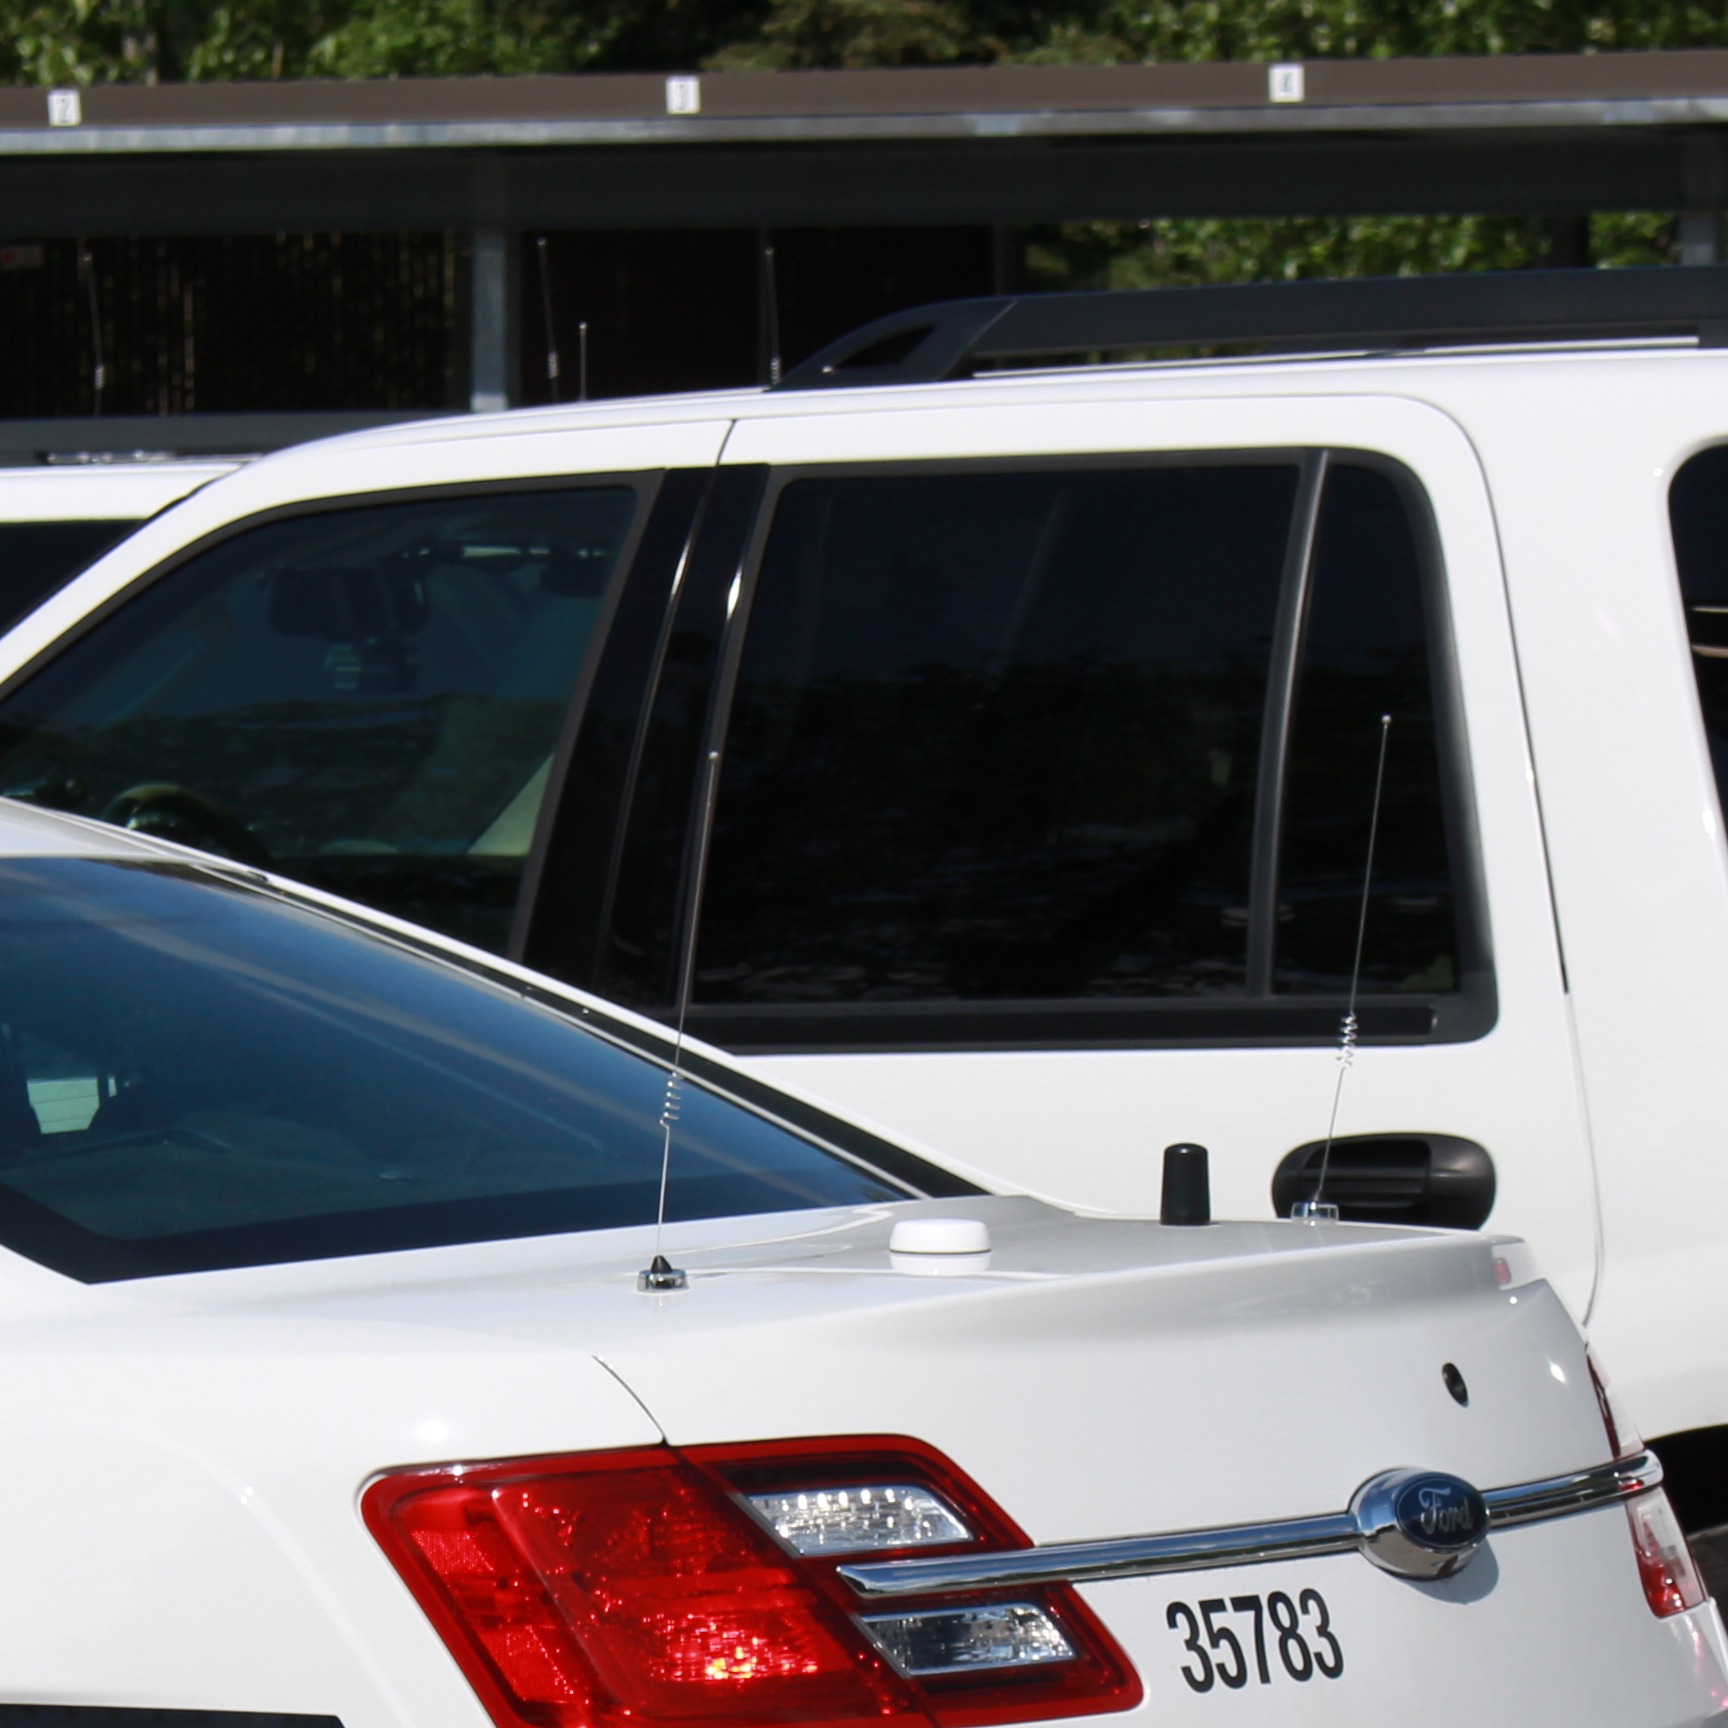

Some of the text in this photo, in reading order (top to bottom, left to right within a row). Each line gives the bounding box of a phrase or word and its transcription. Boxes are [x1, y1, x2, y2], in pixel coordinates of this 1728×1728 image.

[57, 97, 73, 124] 2
[1418, 1487, 1473, 1535] Ford
[1167, 1588, 1344, 1693] 35783
